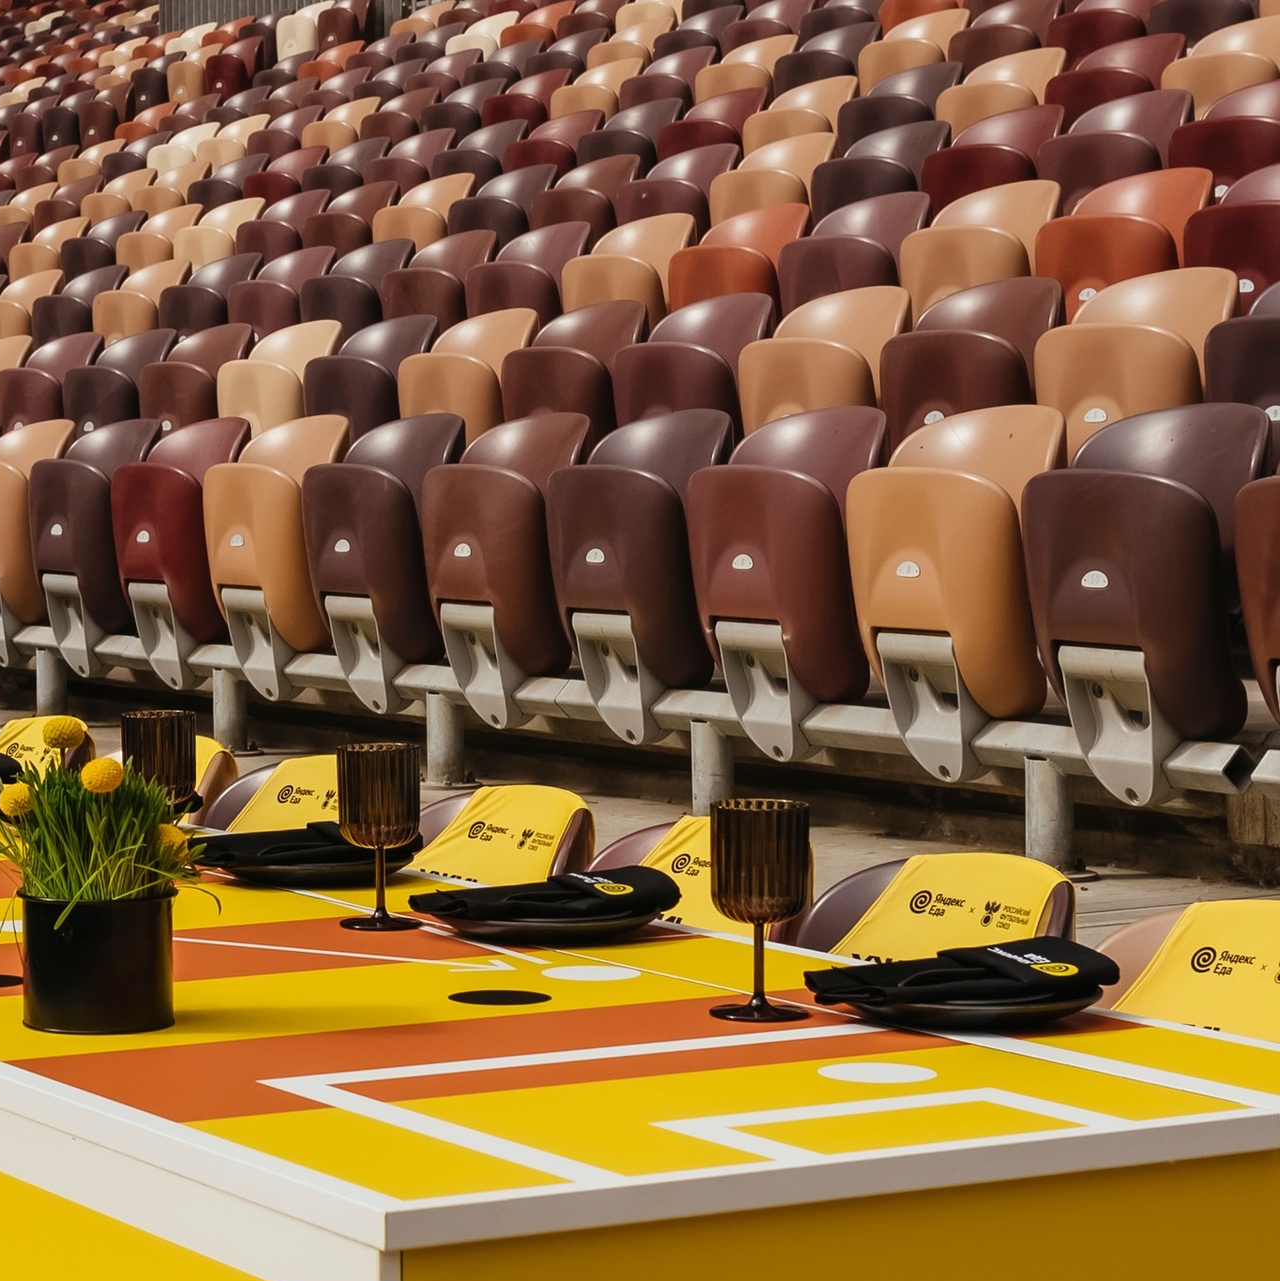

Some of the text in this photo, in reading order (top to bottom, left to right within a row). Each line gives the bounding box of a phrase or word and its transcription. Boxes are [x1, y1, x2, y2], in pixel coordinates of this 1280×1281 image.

[933, 893, 966, 908] Яндекс
[927, 904, 946, 917] Еда
[1218, 950, 1257, 965] Яндекс
[1213, 962, 1234, 976] Еда
